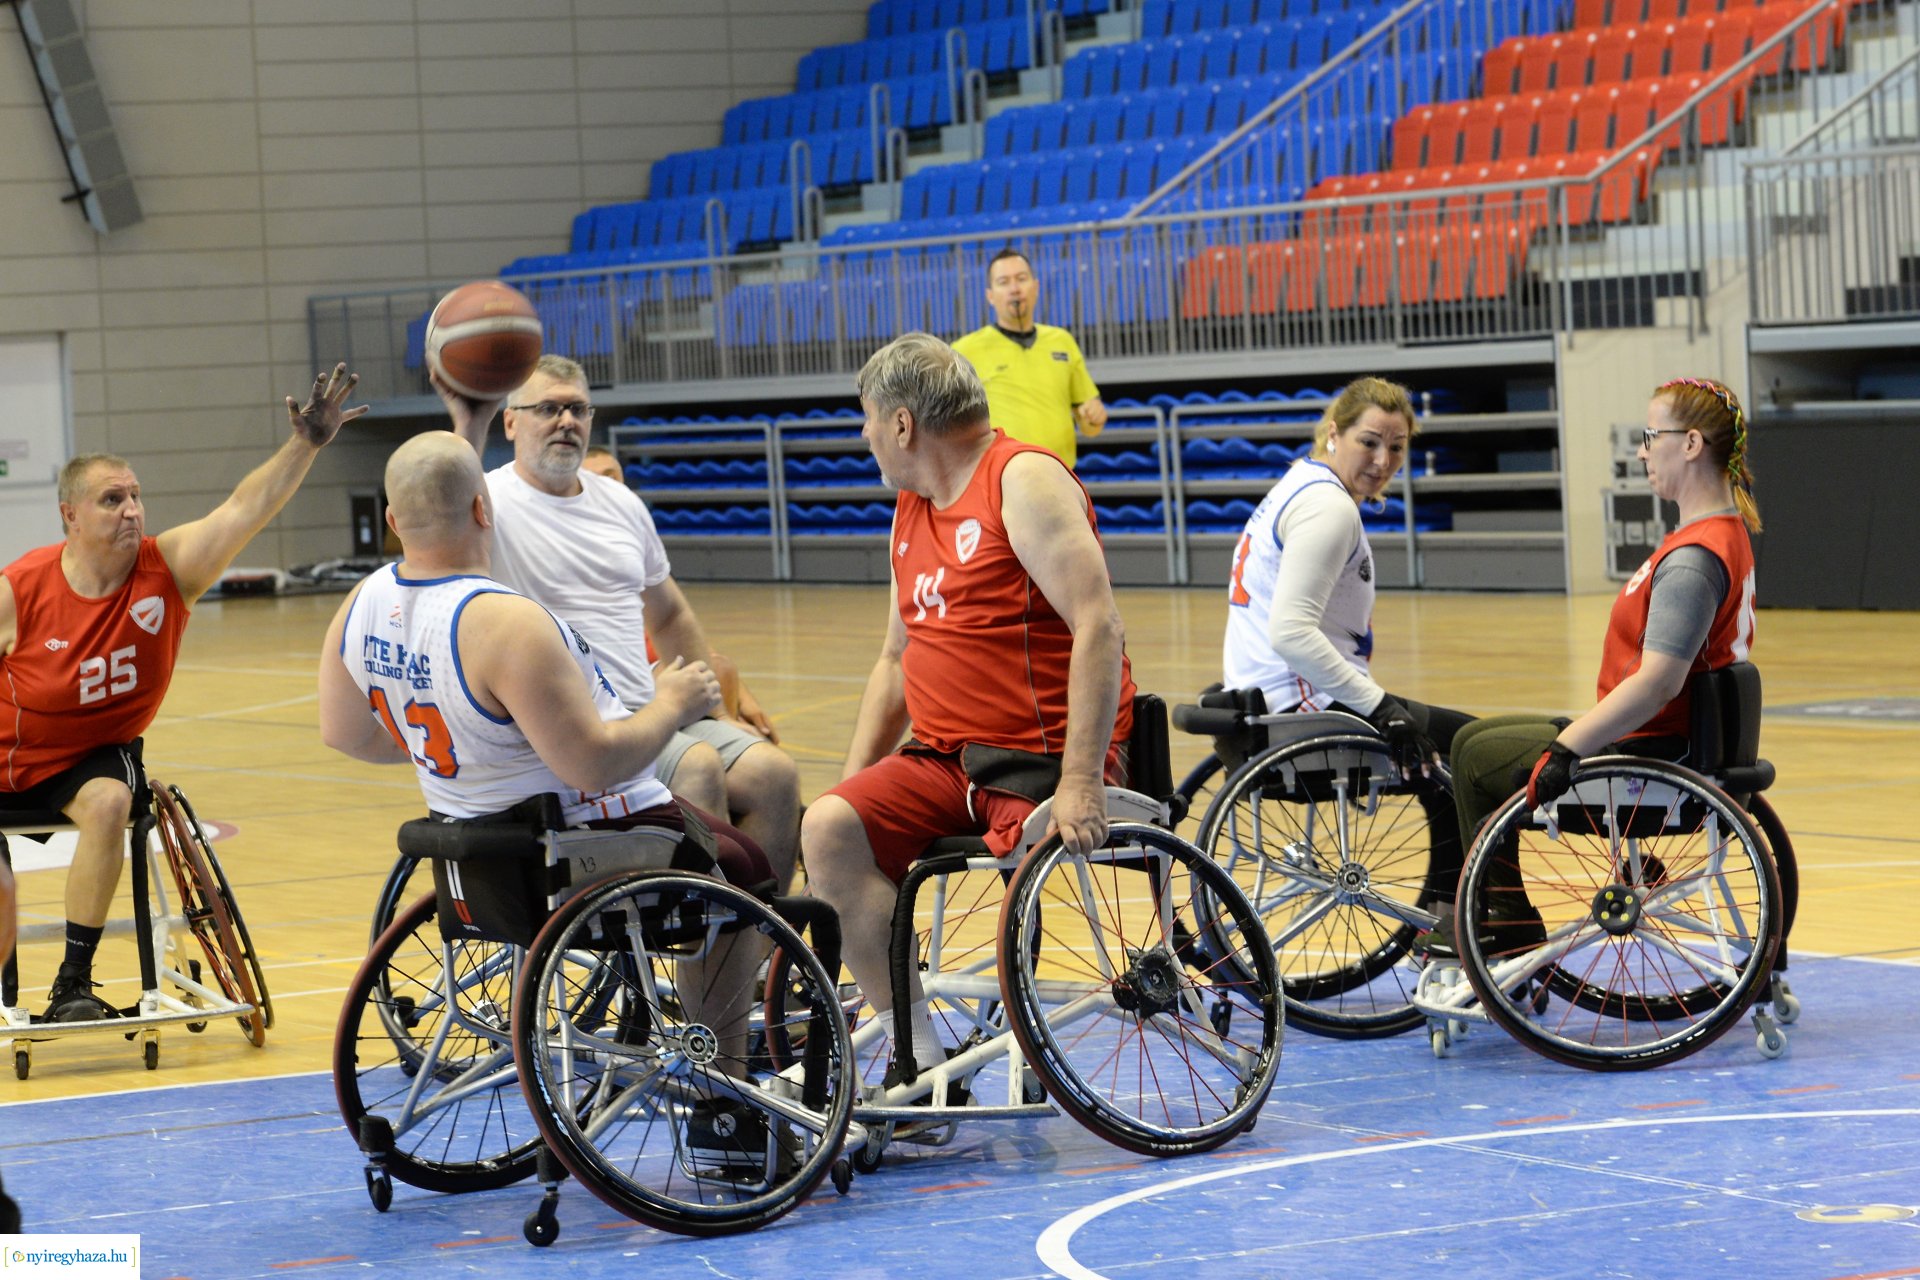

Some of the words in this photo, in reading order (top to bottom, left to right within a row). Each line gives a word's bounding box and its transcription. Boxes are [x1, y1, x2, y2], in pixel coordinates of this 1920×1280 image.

[913, 567, 947, 622] 14
[80, 645, 137, 705] 25
[369, 685, 460, 779] 13
[579, 857, 596, 873] 13
